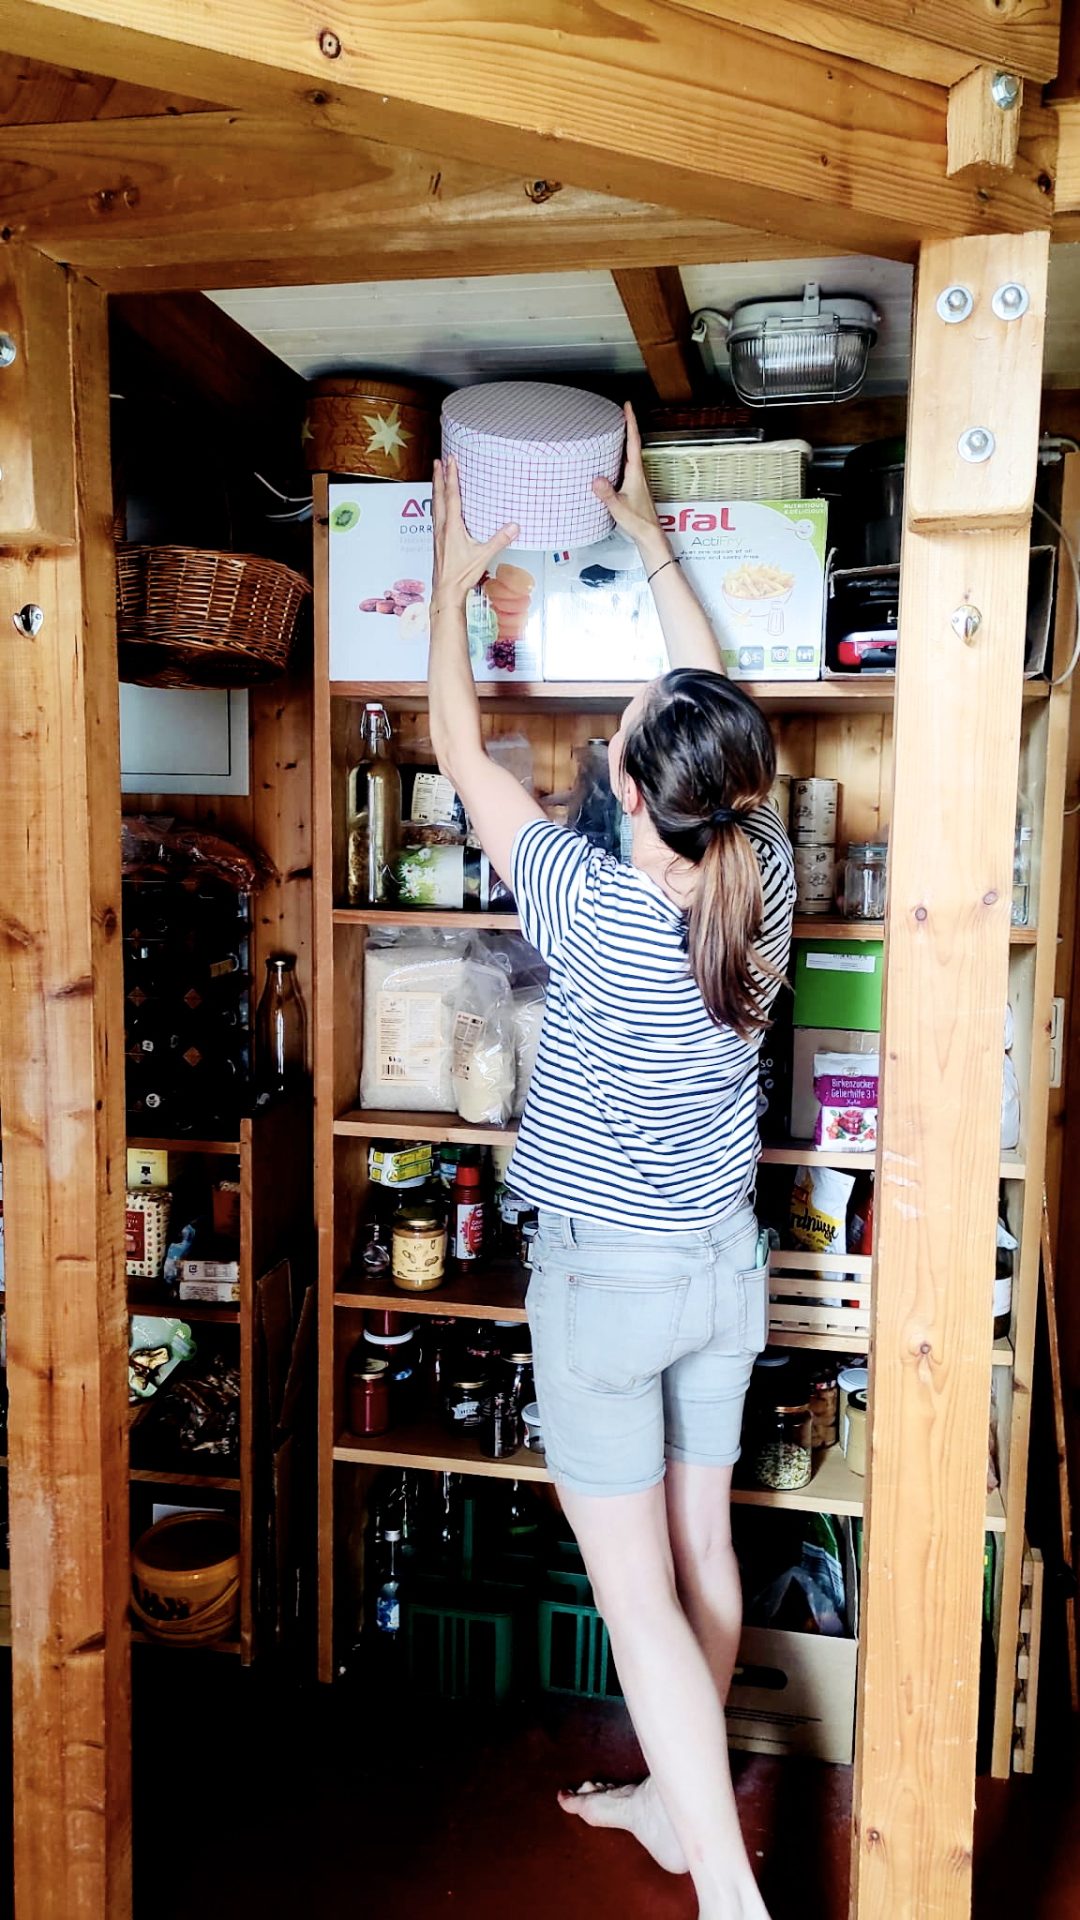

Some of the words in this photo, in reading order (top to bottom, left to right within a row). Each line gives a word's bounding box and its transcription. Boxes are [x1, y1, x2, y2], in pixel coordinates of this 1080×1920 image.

[657, 507, 736, 532] efal
[400, 525, 433, 534] DORR
[831, 1078, 875, 1089] Birkenzucker
